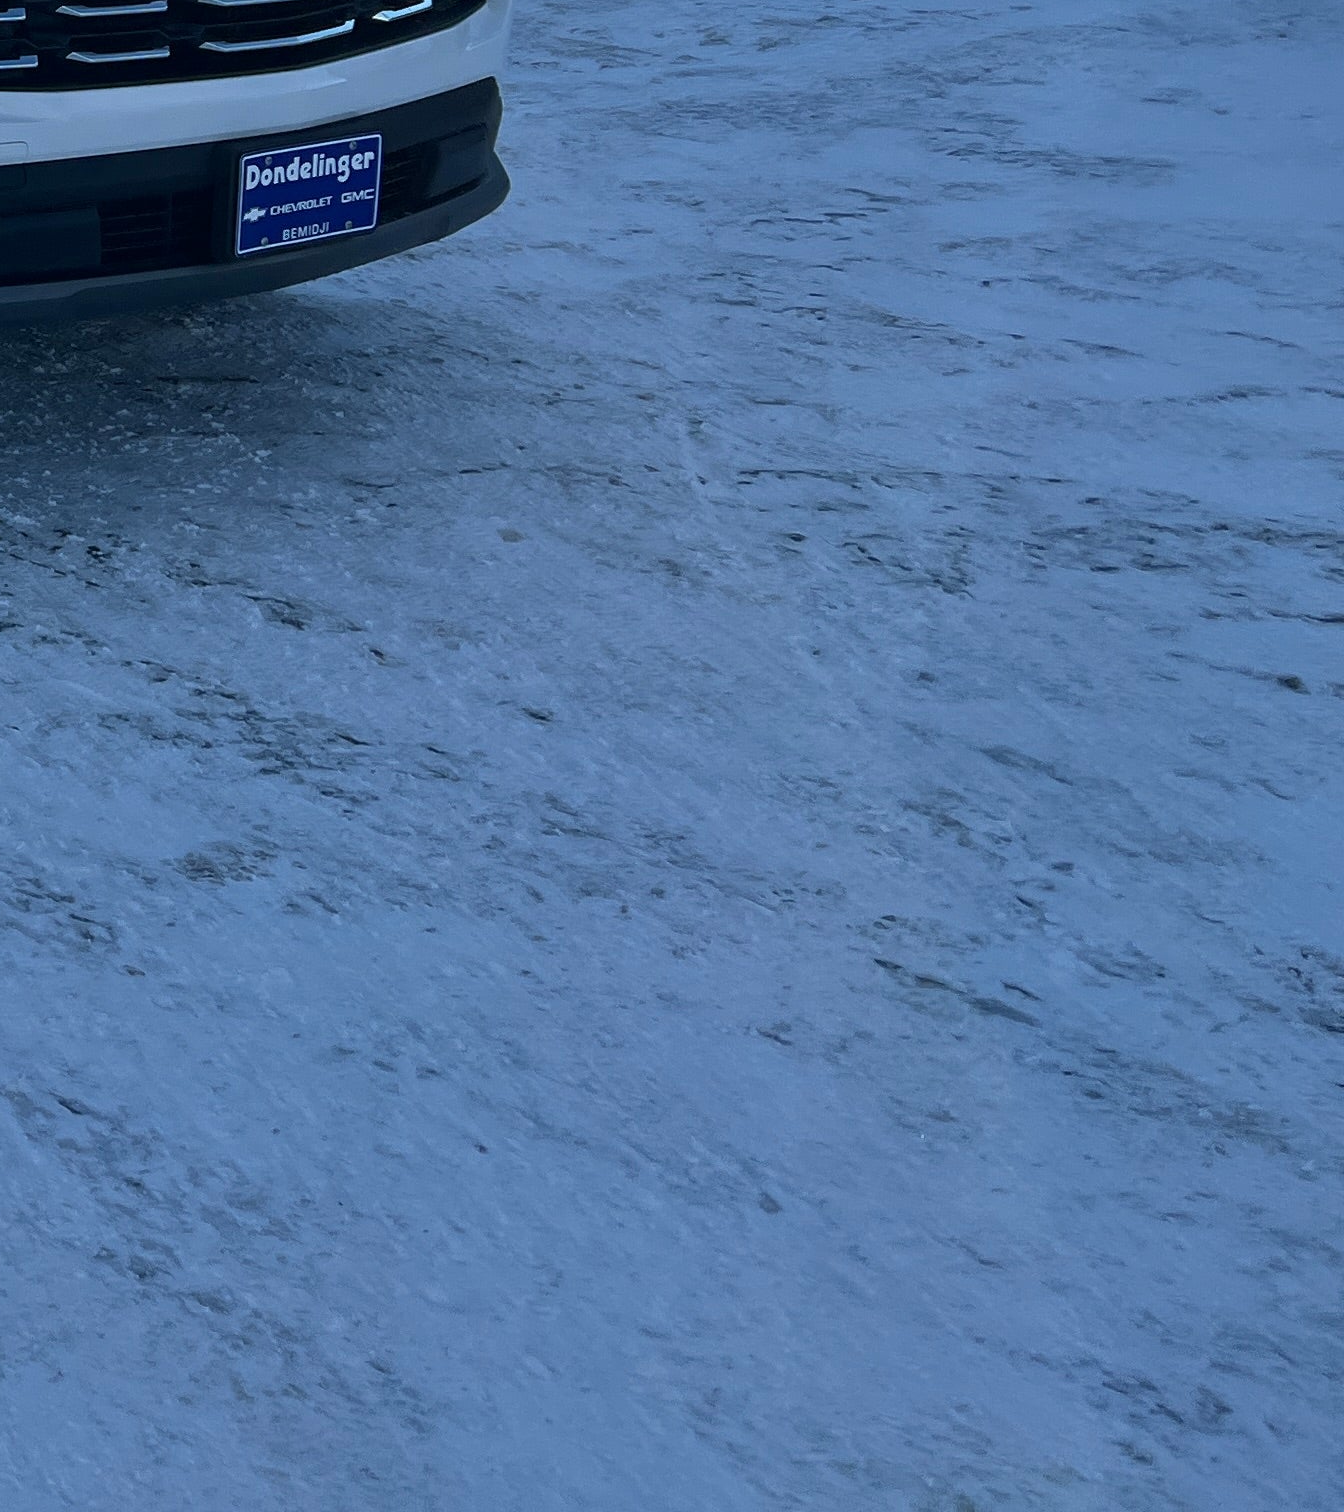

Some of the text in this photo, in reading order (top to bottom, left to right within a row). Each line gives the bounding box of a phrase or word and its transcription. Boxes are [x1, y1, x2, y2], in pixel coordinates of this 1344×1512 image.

[245, 150, 375, 190] Dondelinger
[270, 188, 375, 216] CHEVROLET GMC
[282, 221, 330, 241] BEMIDJI
